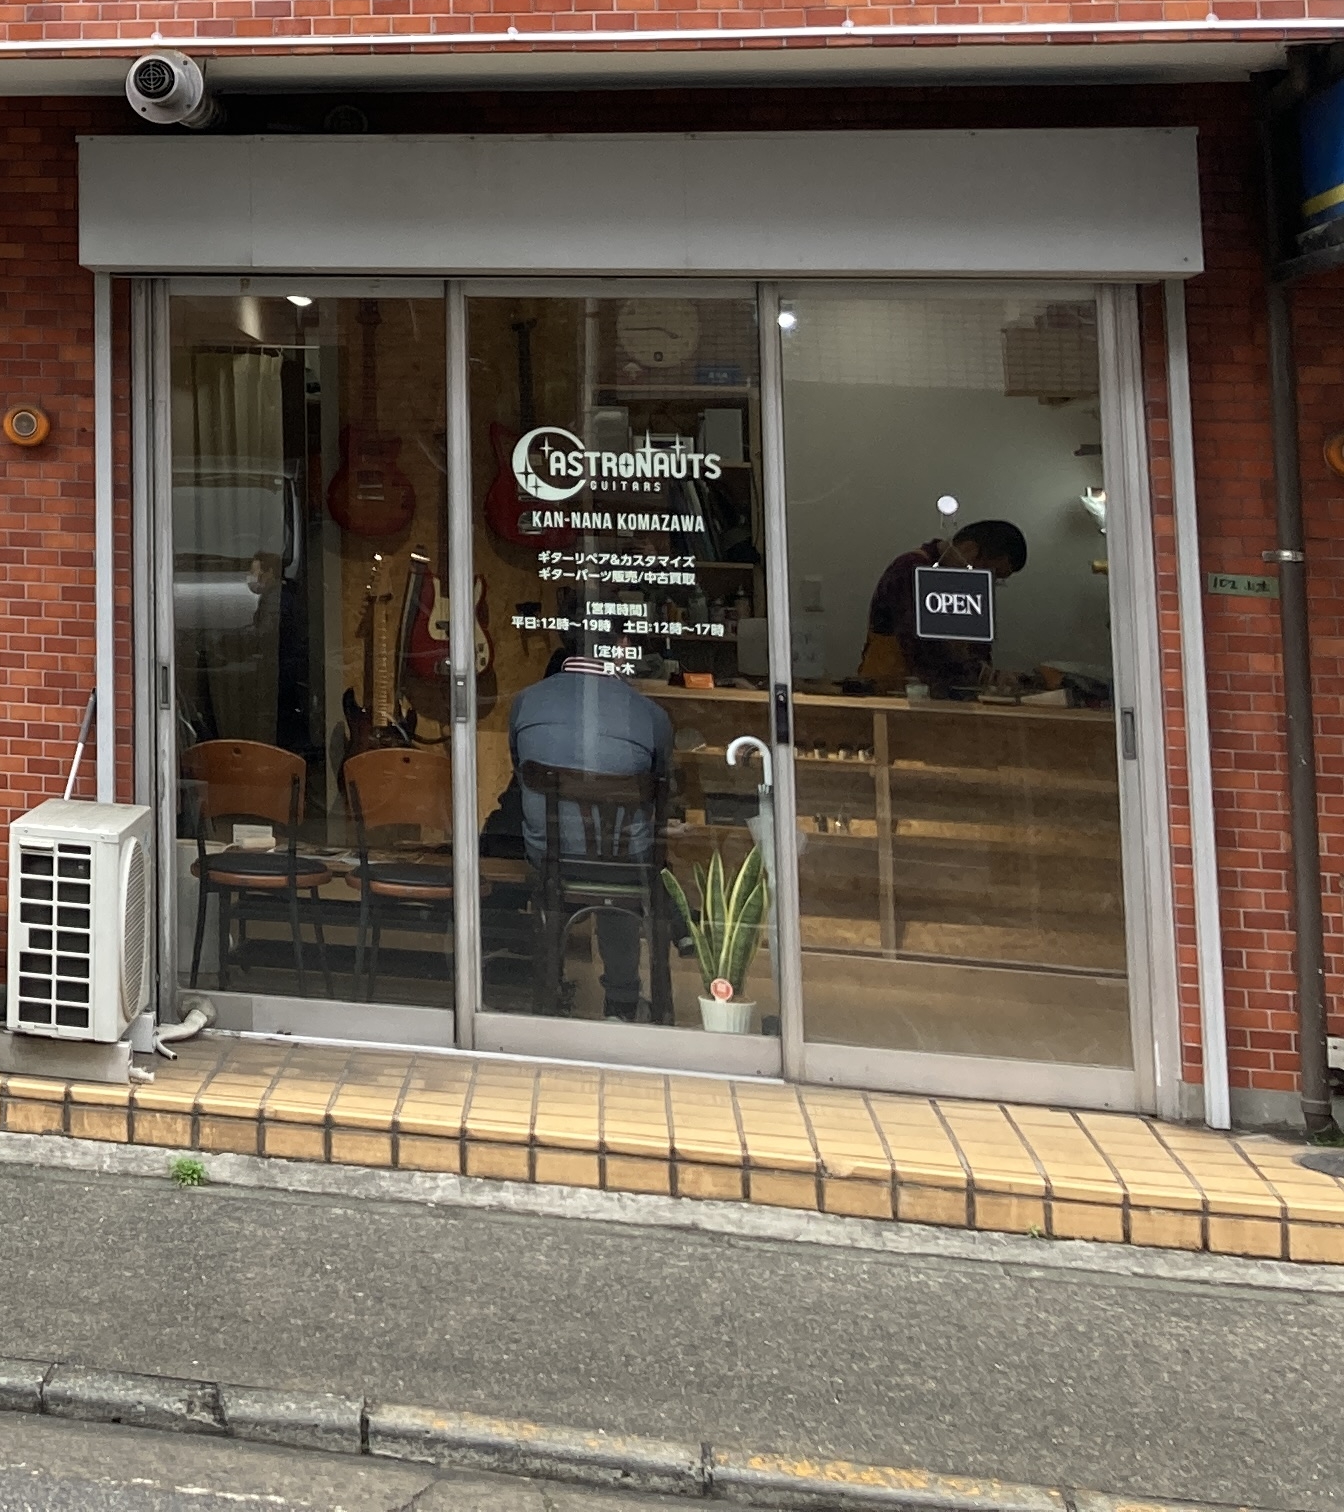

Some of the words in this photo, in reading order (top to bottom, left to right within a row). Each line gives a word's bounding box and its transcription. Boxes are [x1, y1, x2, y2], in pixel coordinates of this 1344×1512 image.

[550, 451, 722, 480] ASTRONAUTS
[590, 480, 662, 492] GUITARS
[532, 510, 612, 529] KAN-NANA
[617, 513, 705, 533] KOMAZAWA
[925, 592, 982, 615] OPEN
